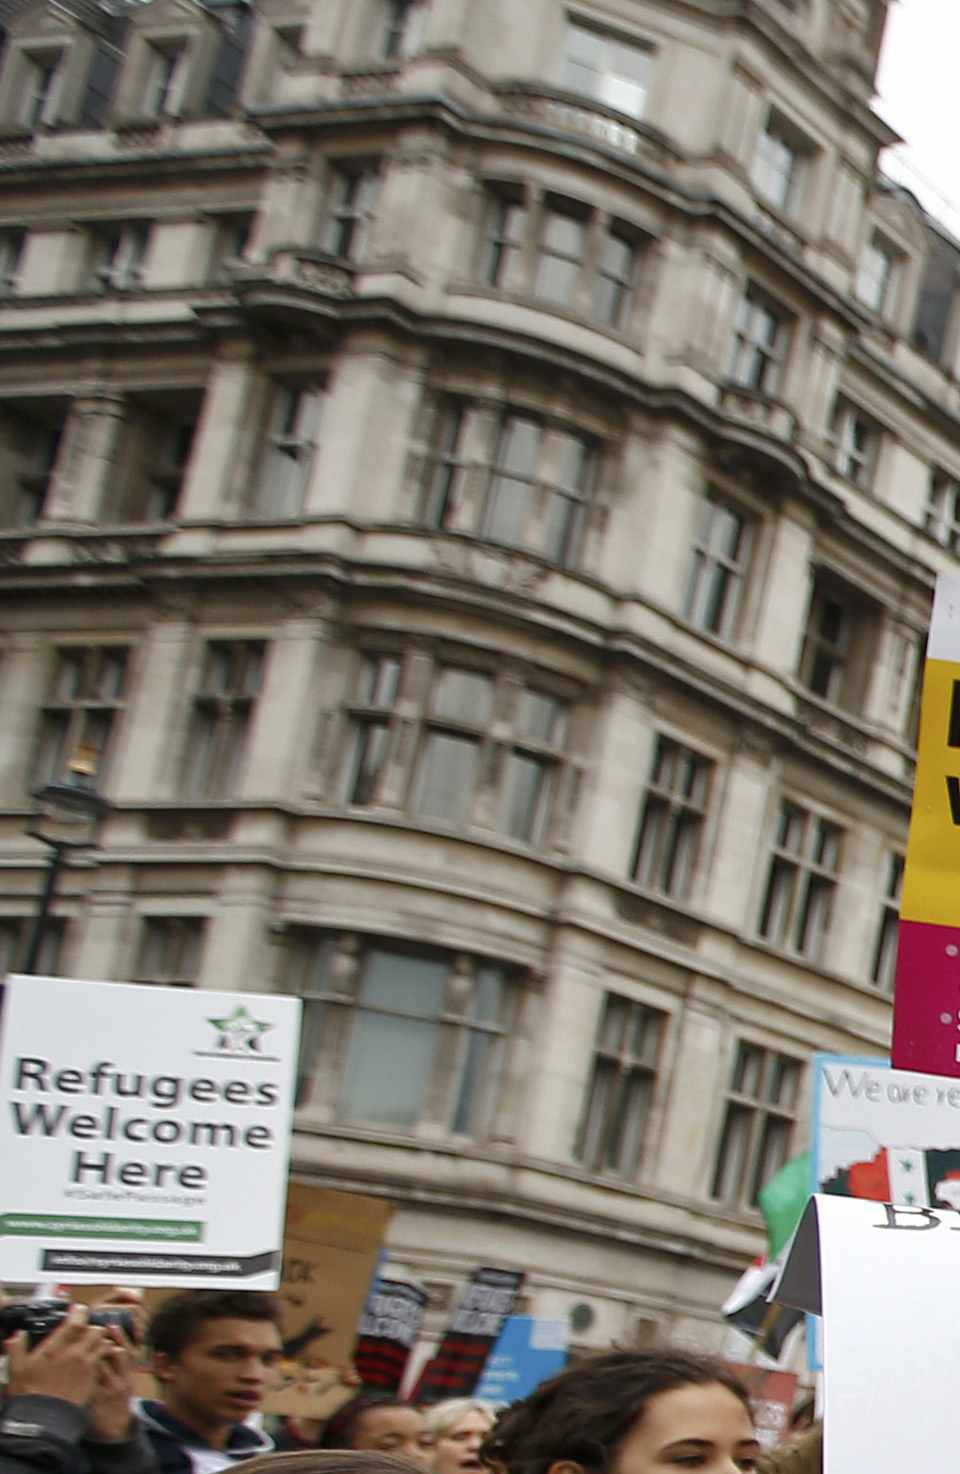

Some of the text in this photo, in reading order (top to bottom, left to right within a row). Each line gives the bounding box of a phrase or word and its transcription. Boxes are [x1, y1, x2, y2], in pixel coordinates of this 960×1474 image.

[14, 1056, 277, 1110] Refugees
[822, 1068, 882, 1102] We
[887, 1084, 928, 1106] are
[10, 1102, 273, 1149] Welcome
[72, 1150, 208, 1189] Here
